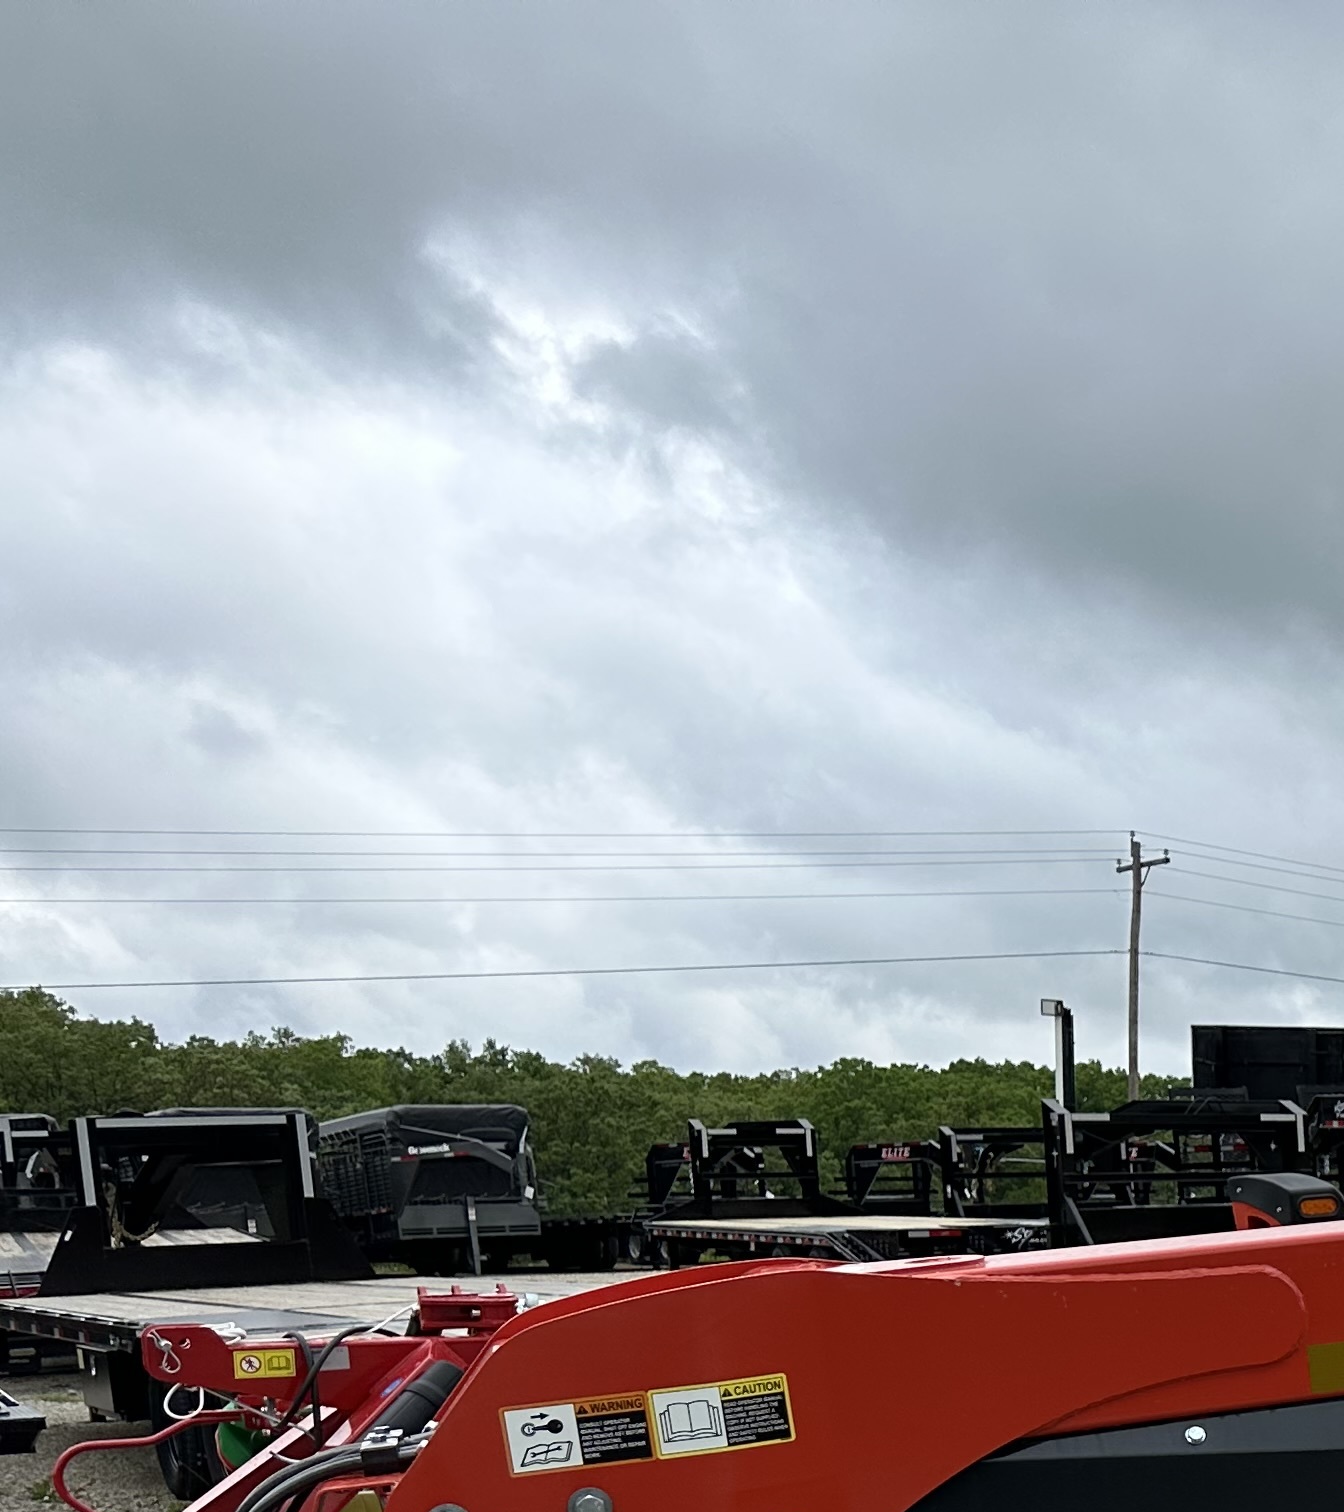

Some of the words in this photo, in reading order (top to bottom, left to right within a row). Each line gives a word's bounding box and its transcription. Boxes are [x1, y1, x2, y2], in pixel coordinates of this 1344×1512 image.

[881, 1147, 911, 1160] ELITE
[734, 1379, 782, 1397] CAUTION
[589, 1398, 643, 1414] WARNING
